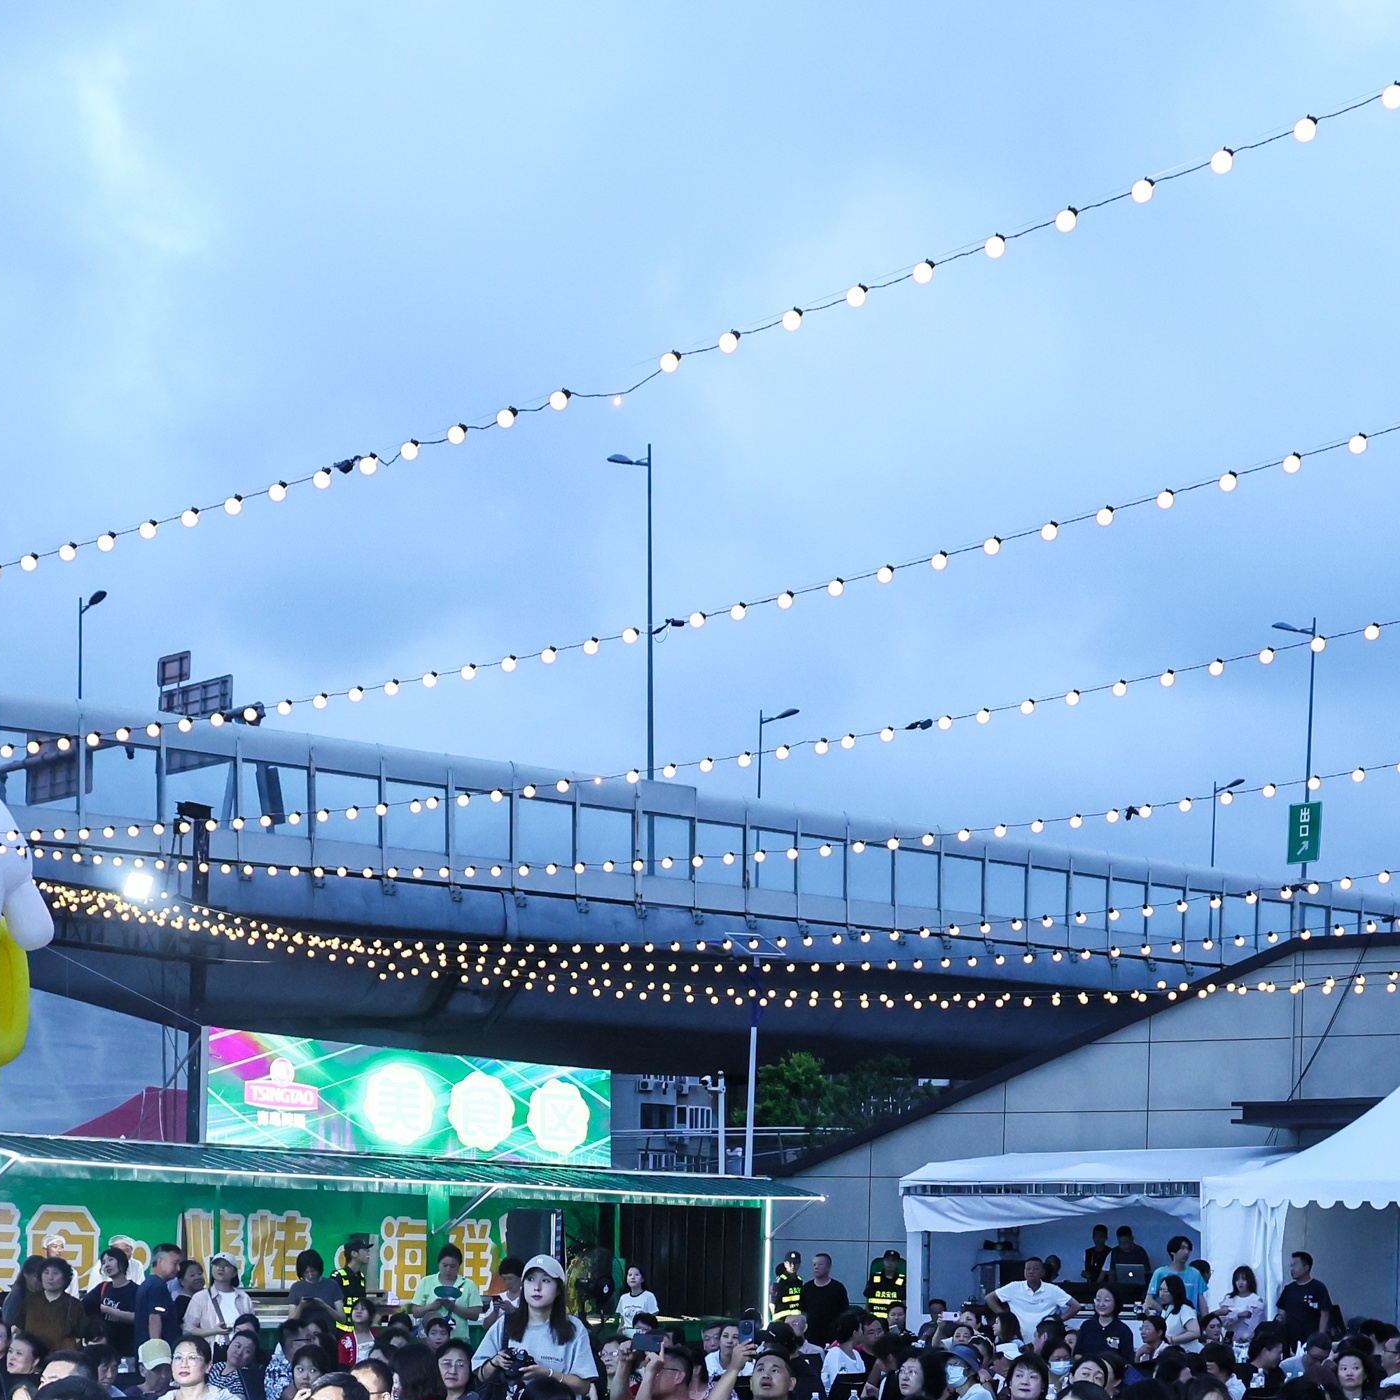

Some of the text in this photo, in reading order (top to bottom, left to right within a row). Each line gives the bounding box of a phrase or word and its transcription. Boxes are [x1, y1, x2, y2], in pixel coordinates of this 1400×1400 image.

[1299, 807, 1311, 837] 出口
[249, 1085, 314, 1106] TSINGTAO
[376, 1077, 580, 1143] 美食区
